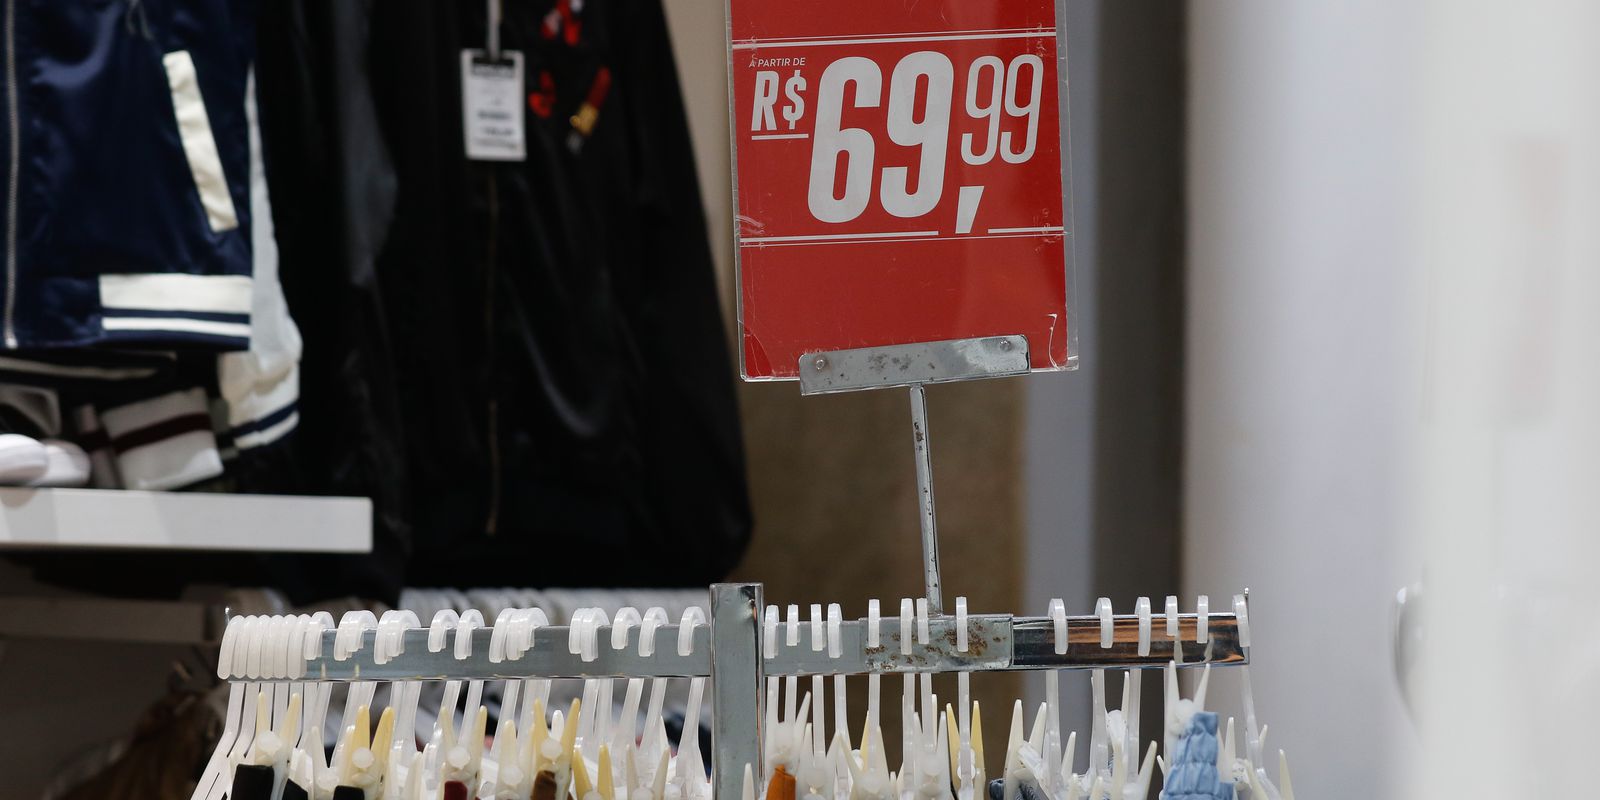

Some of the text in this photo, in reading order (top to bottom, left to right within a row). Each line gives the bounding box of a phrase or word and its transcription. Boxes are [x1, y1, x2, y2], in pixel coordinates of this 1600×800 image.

[757, 57, 791, 67] PARTIR
[792, 57, 806, 66] DE
[751, 70, 807, 131] R$
